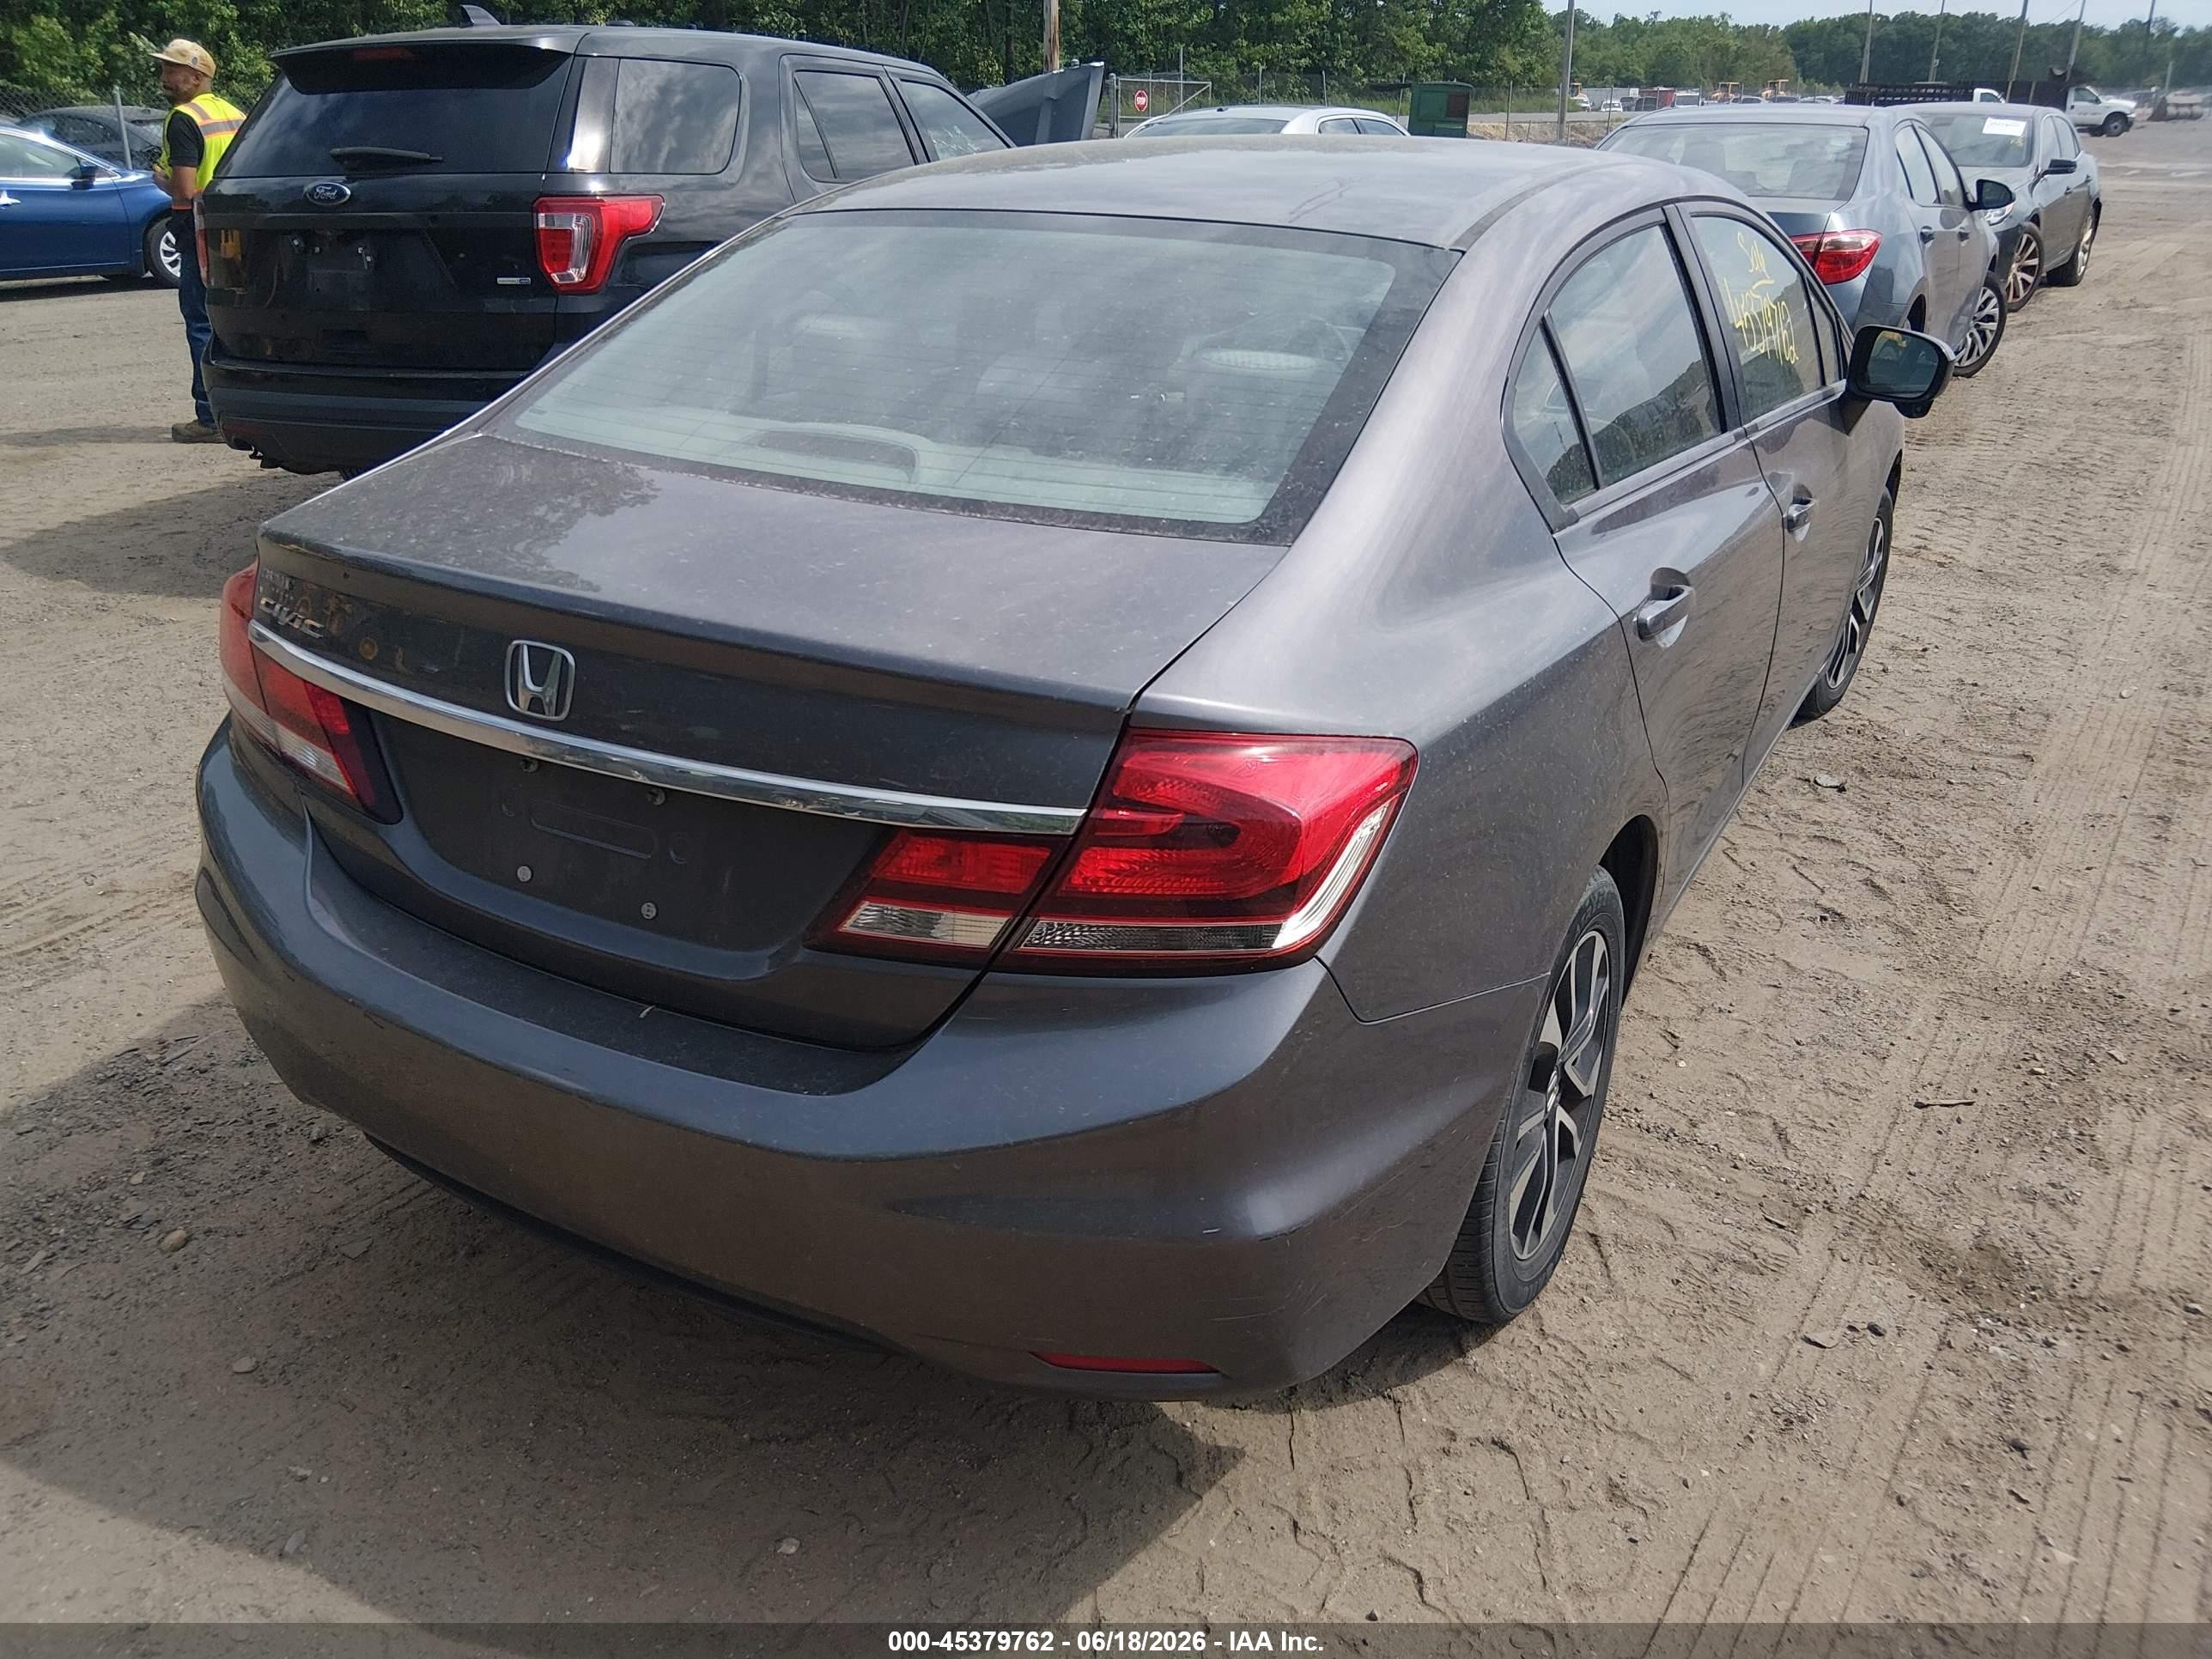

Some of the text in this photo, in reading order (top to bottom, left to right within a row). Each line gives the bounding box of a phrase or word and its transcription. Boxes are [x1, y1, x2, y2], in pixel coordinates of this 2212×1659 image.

[1136, 96, 1146, 105] STOP
[313, 185, 337, 199] Ford
[260, 597, 325, 639] CIVIC
